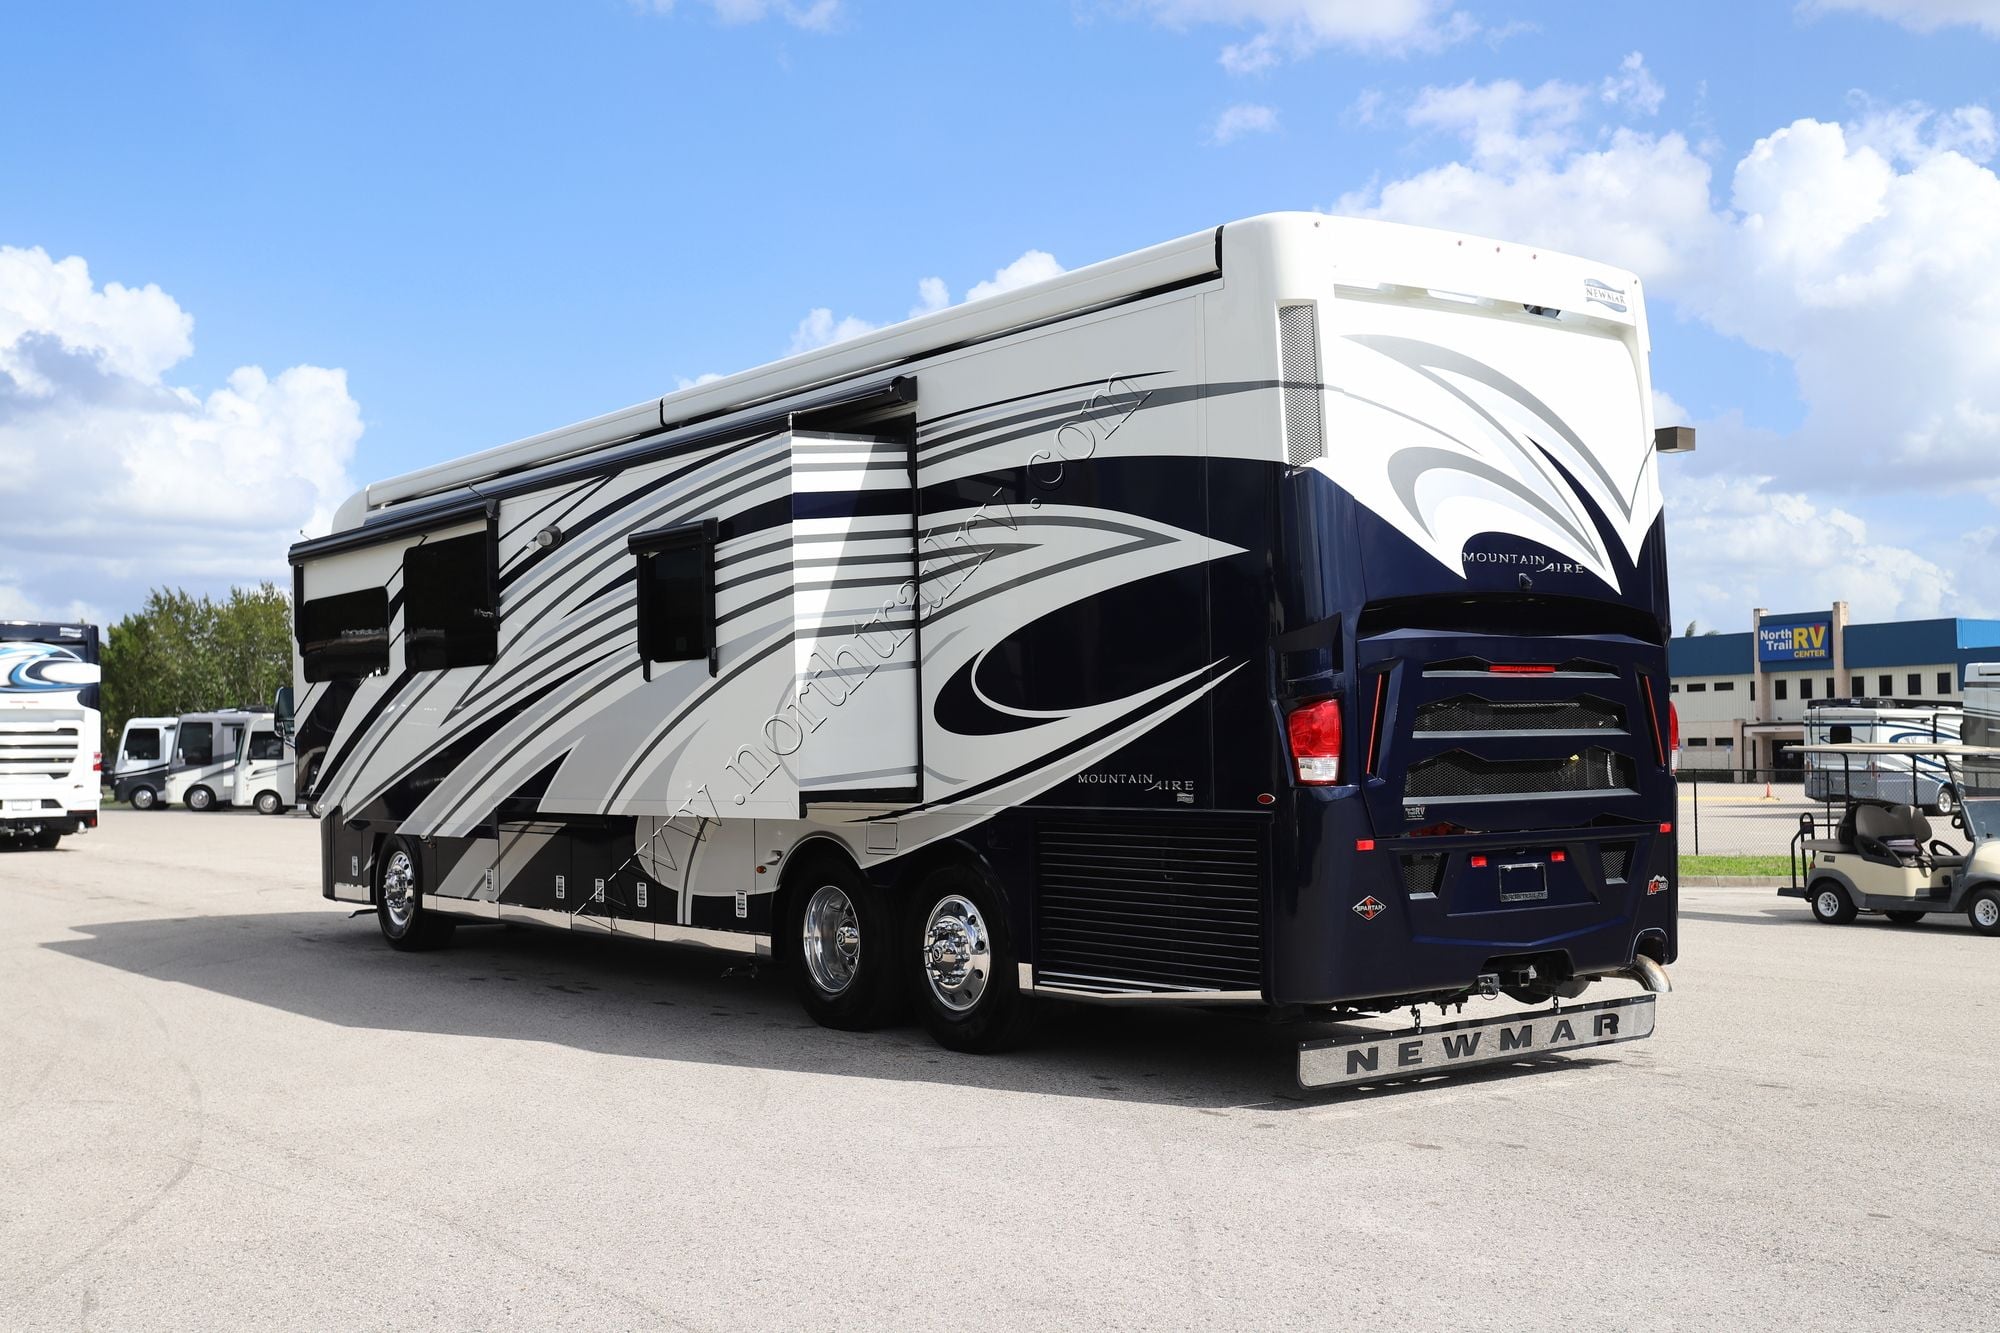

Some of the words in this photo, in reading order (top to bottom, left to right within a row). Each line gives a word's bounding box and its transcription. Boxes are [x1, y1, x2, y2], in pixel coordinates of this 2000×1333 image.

[1585, 287, 1626, 304] NEWMAR
[1462, 552, 1545, 565] MOUNTAIN
[1536, 563, 1584, 574] AIRE
[1760, 629, 1792, 640] North
[1793, 626, 1826, 649] RV
[1766, 640, 1792, 651] Trail
[1794, 650, 1826, 658] CENTER
[1078, 774, 1153, 784] MOUNTAIN
[1144, 780, 1195, 791] AIRE
[1346, 1013, 1620, 1075] NEWMAR
